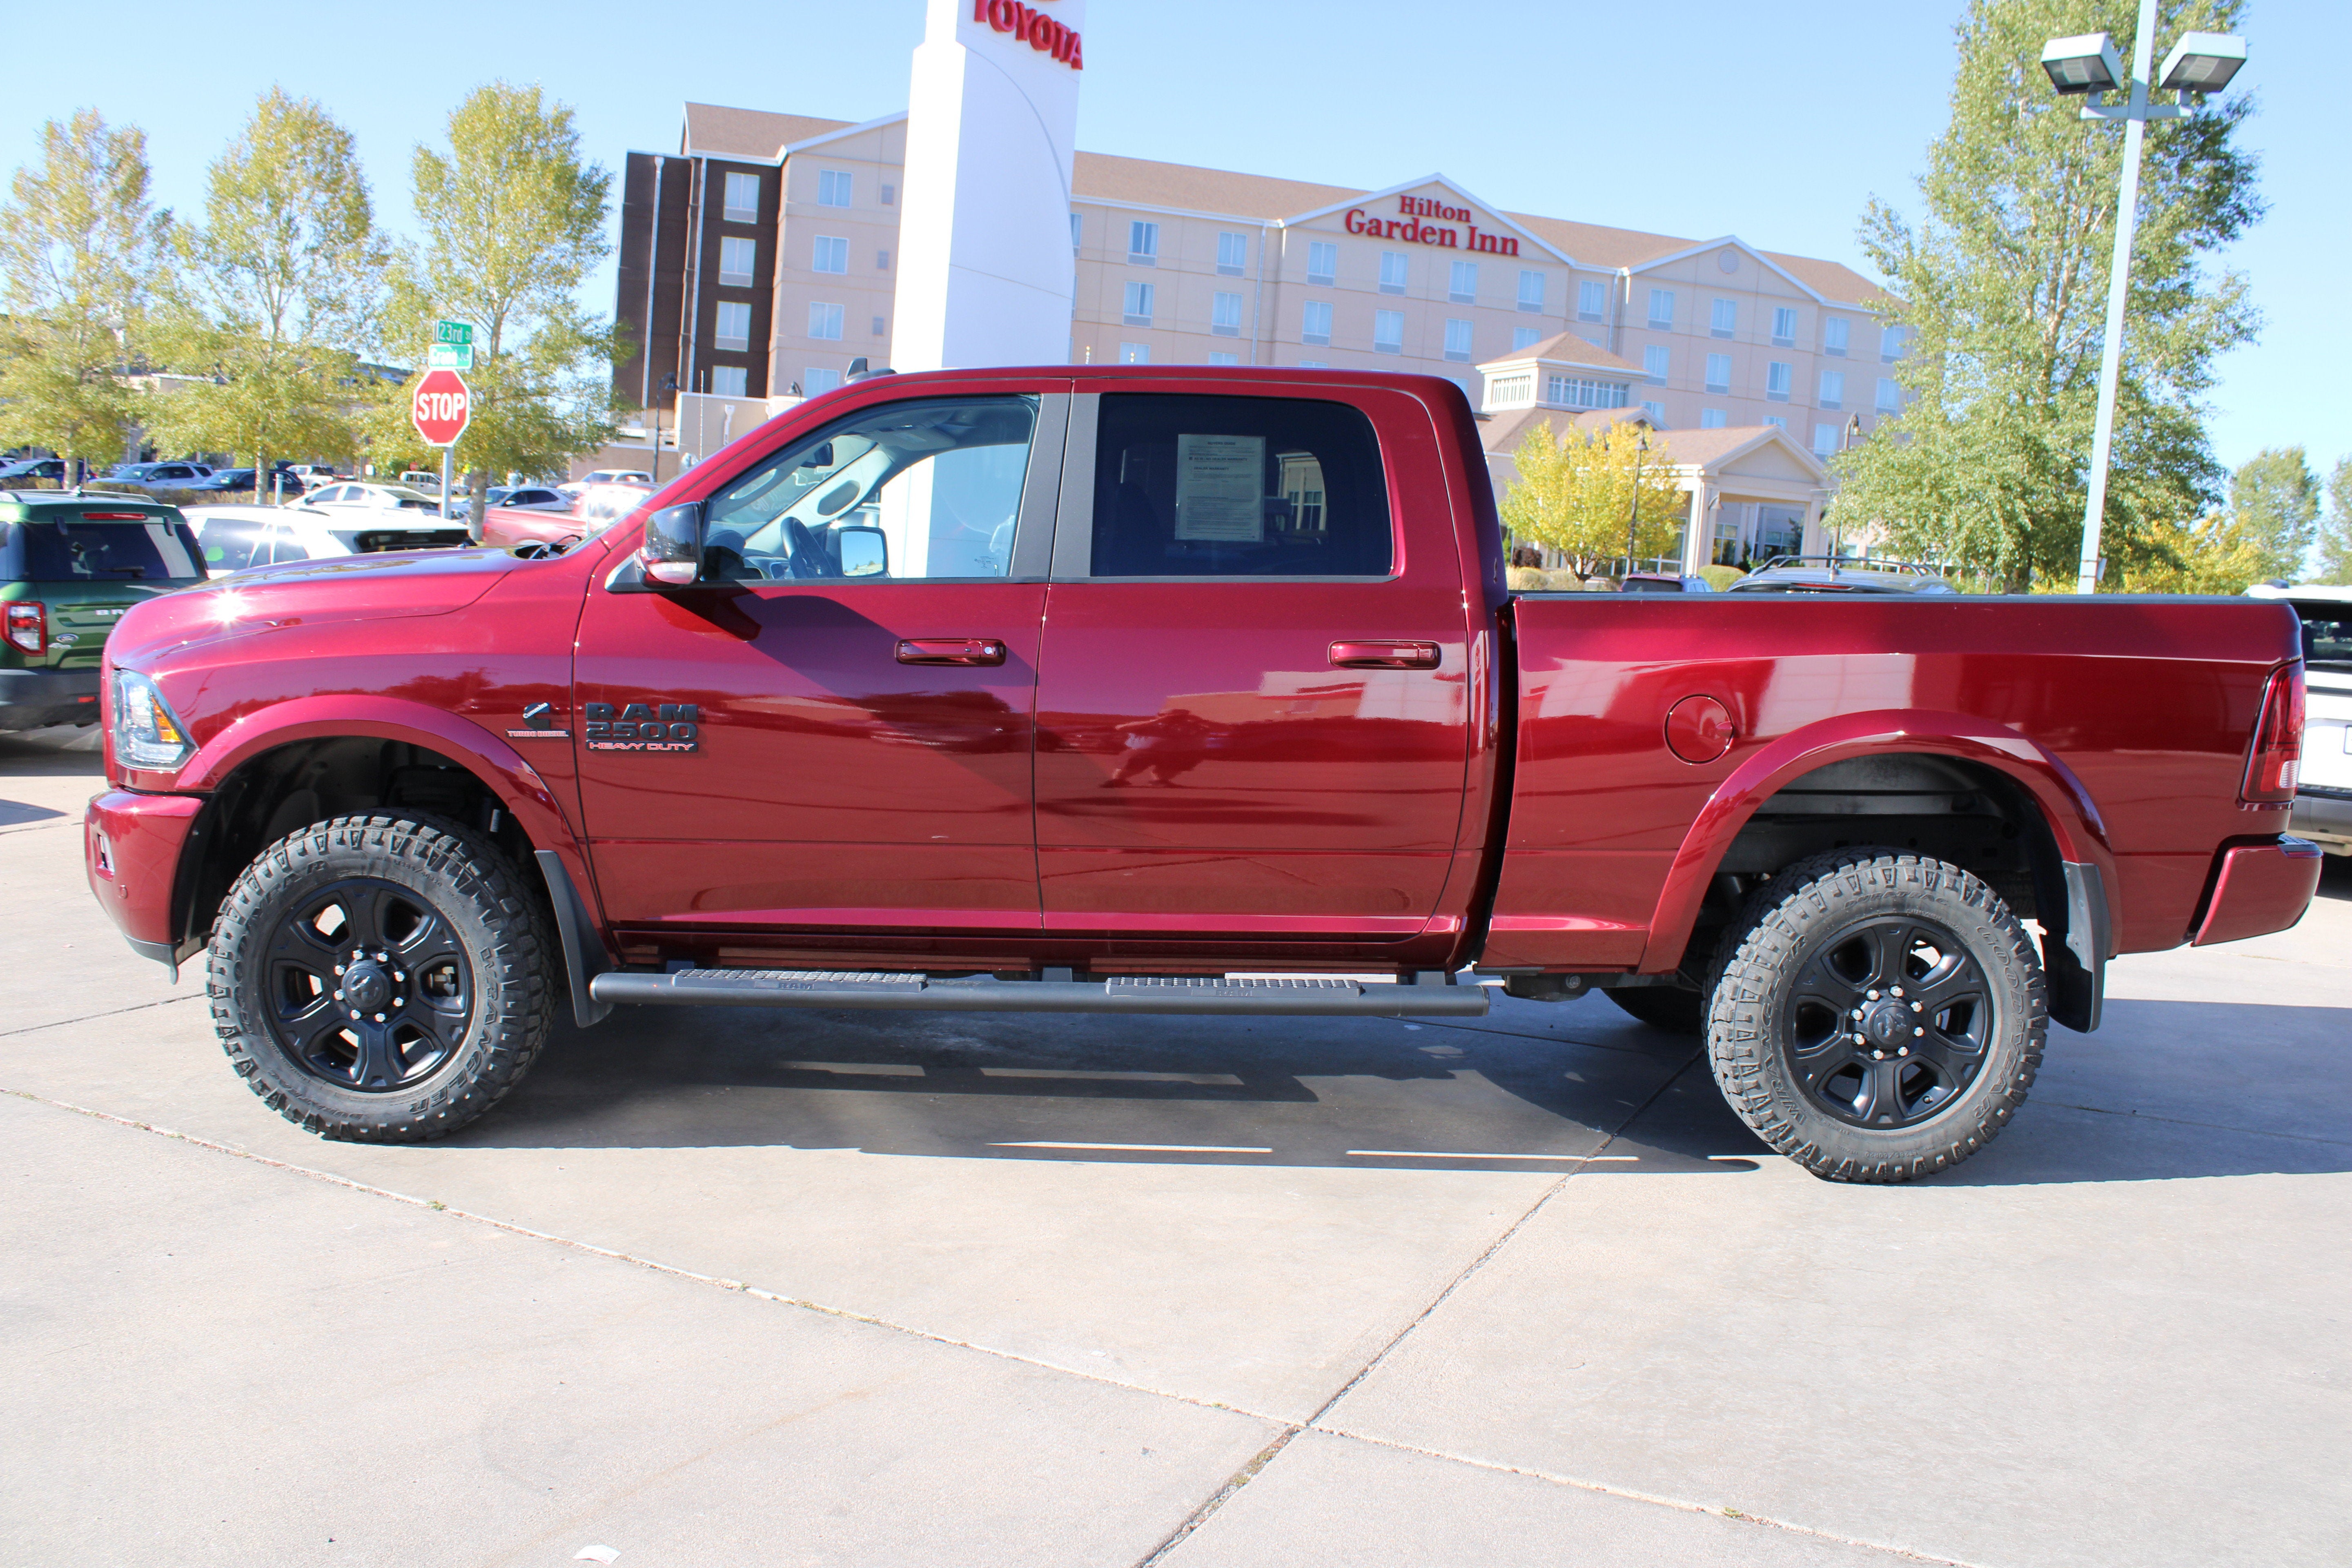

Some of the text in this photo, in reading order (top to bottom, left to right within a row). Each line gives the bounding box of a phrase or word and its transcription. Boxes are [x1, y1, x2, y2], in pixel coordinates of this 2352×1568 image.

[1398, 194, 1472, 223] Hilton
[1345, 208, 1519, 256] Garden Inn
[440, 323, 463, 343] 23rd
[417, 393, 466, 421] STOP
[523, 702, 548, 719] Cummins
[586, 702, 698, 721] RAM
[586, 721, 697, 740] 2500
[589, 742, 695, 751] HEAVY DUTY
[1844, 891, 1950, 909] DURATRAC
[409, 947, 498, 1114] WRANGLER
[1761, 935, 1807, 1125] WRANGLER
[1973, 926, 2025, 1119] GOODYEAR
